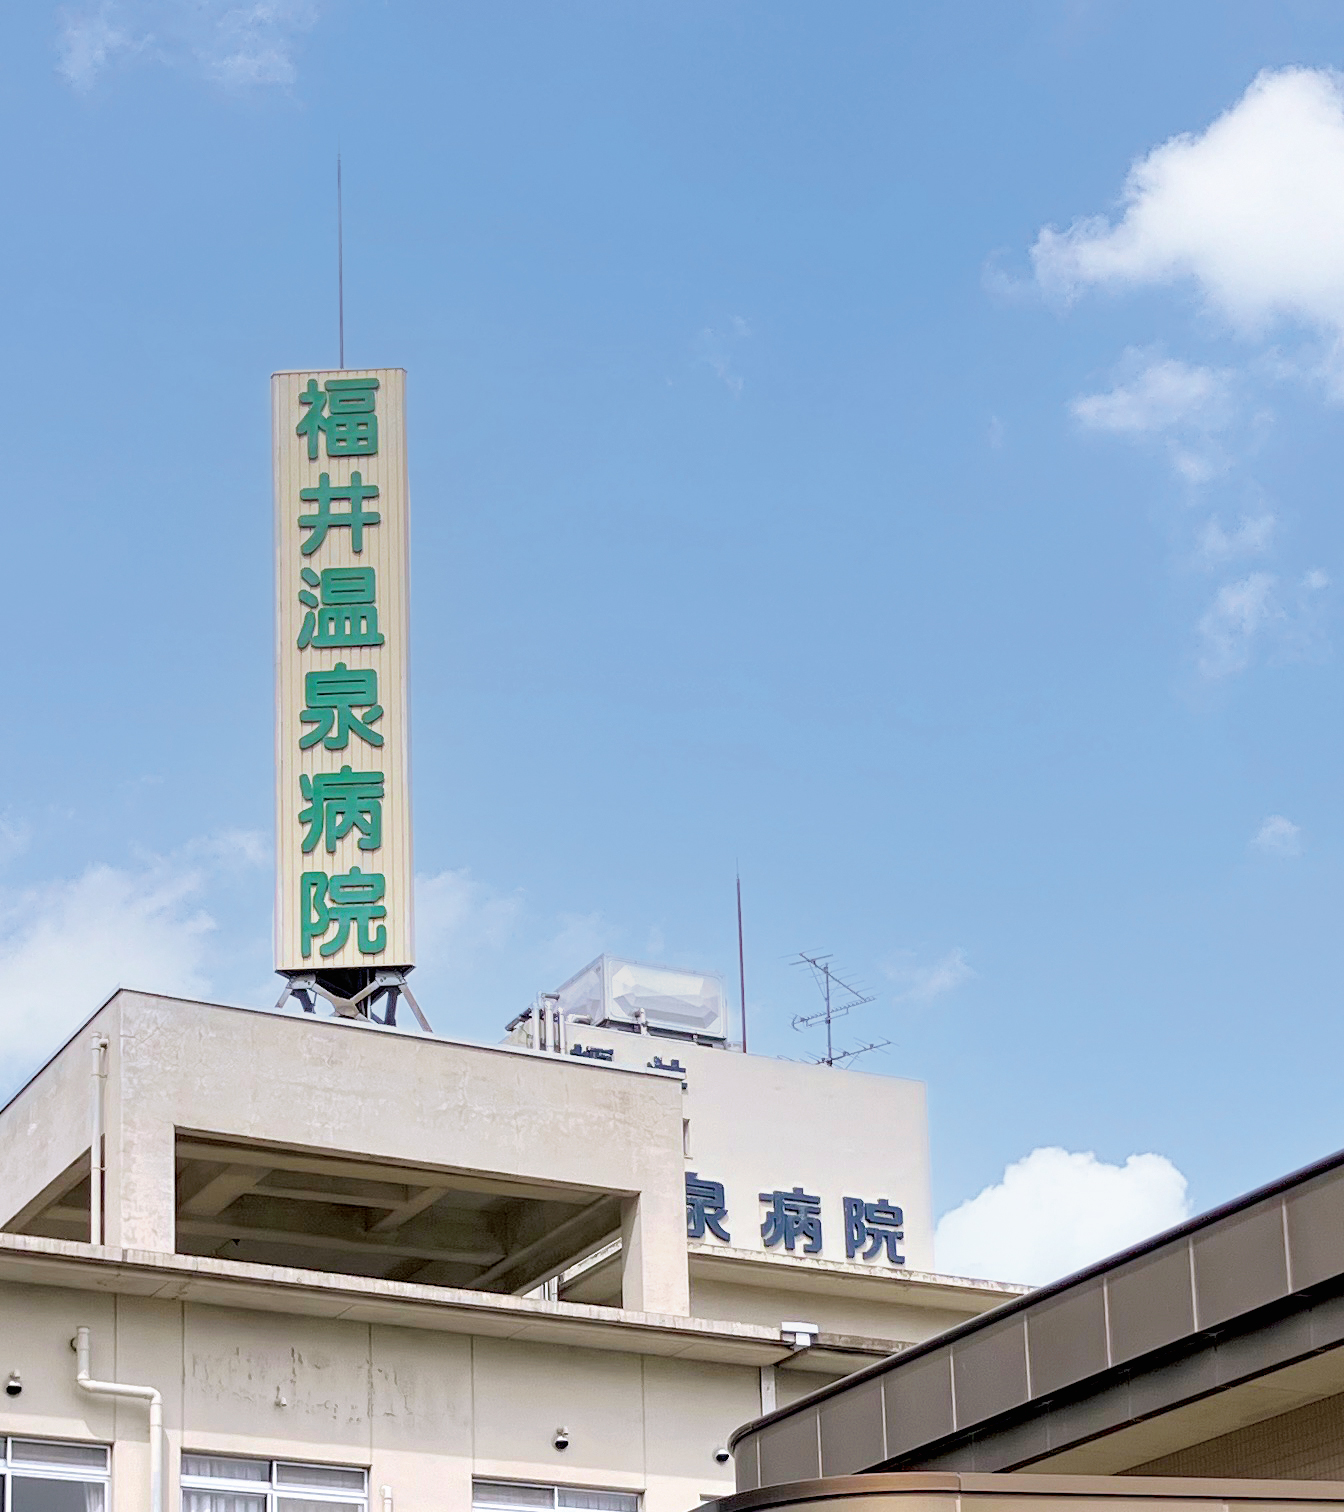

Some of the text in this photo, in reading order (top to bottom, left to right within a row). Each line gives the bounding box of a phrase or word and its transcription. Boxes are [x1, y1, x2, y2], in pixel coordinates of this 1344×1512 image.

[296, 377, 387, 959] 福井温泉病院
